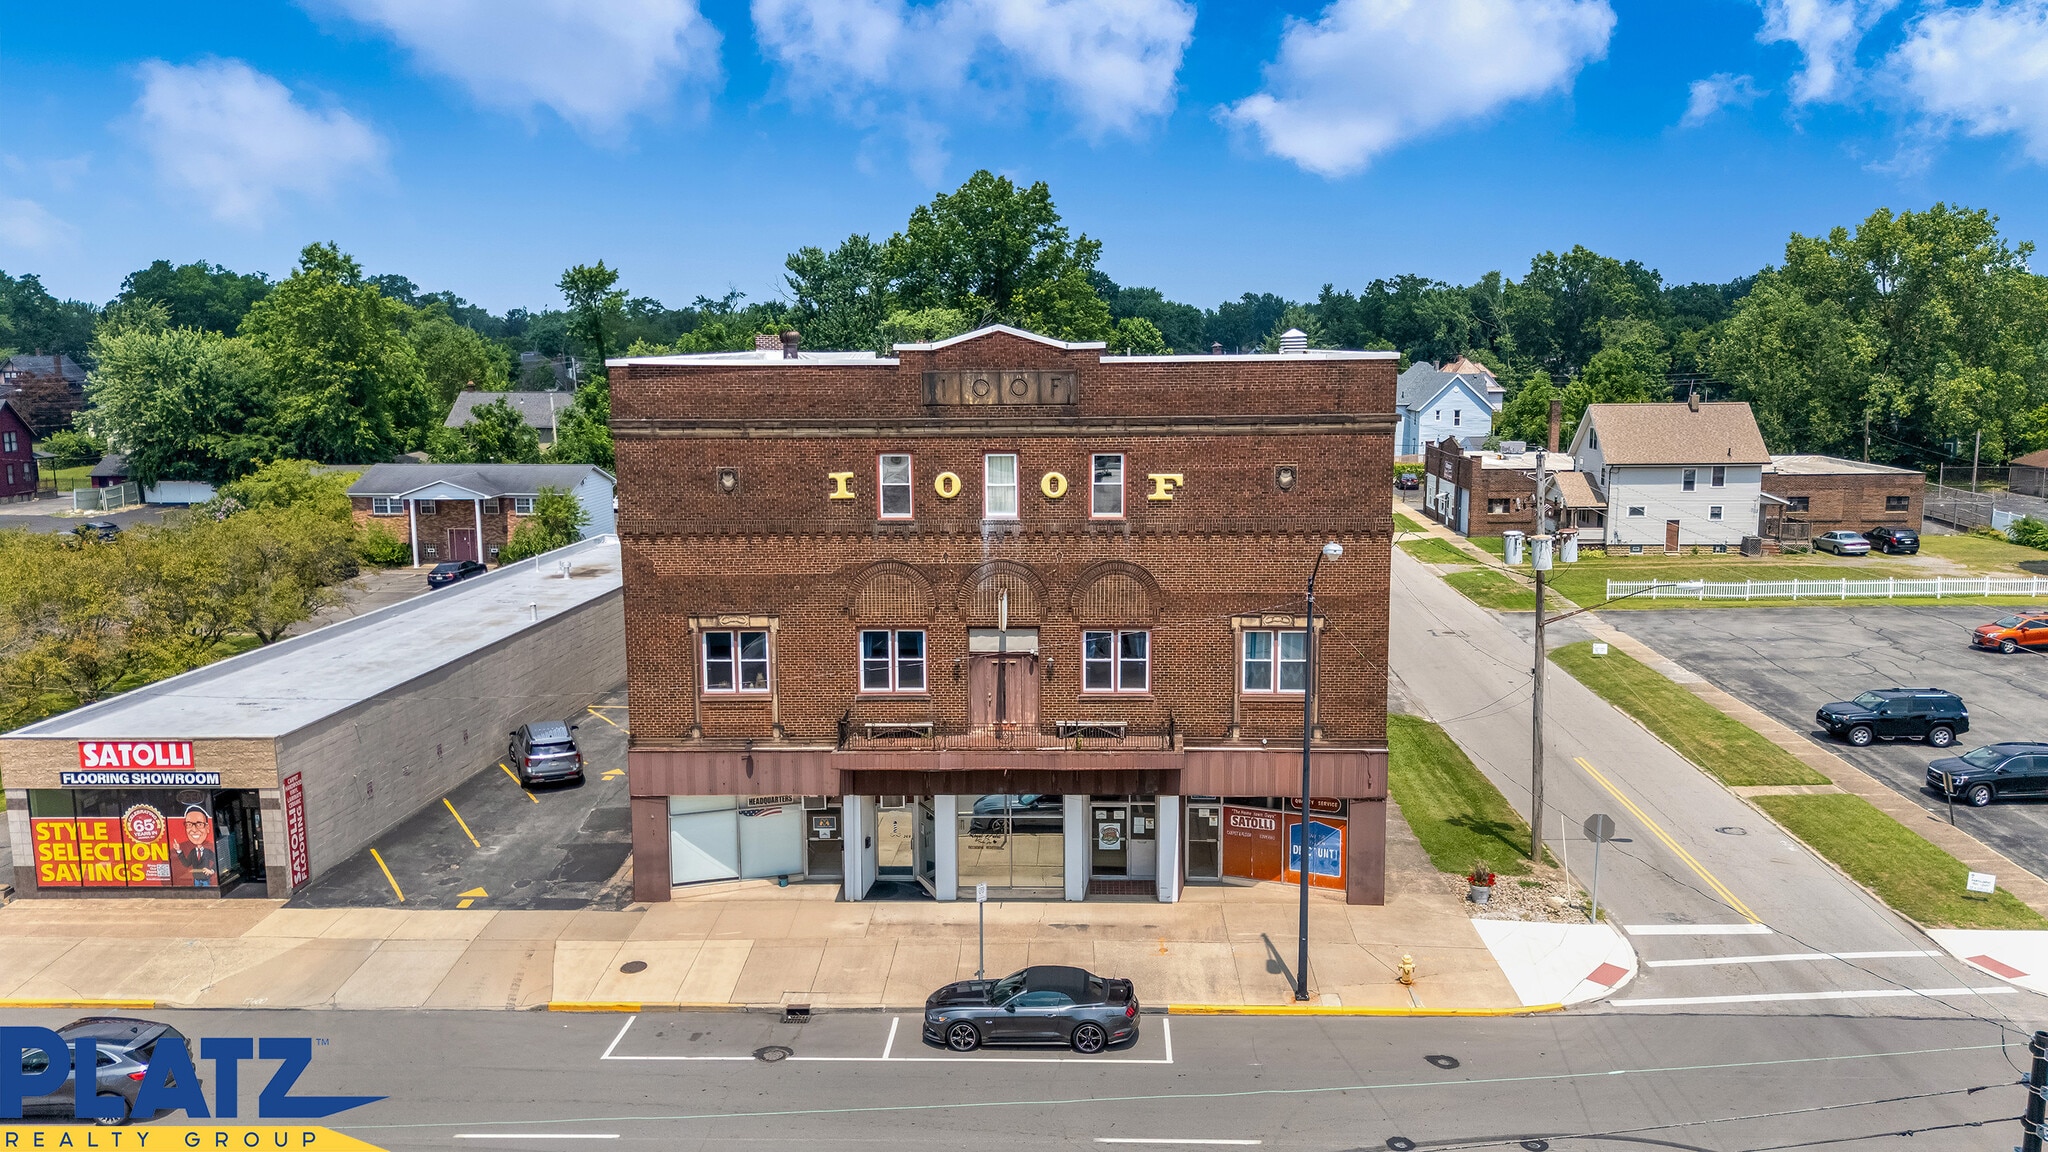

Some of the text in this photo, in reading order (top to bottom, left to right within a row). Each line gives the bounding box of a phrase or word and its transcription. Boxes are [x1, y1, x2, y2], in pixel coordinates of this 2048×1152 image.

[83, 743, 191, 767] SATOLLI
[62, 773, 219, 784] FLOORING SHOWROOM
[748, 795, 792, 805] HEADQUARTERS
[36, 822, 108, 841] STYLE
[1232, 816, 1273, 829] SATOLLI
[38, 842, 169, 862] SELECTION
[289, 807, 302, 885] SATOLLI
[296, 806, 308, 881] FLOORING
[40, 863, 145, 882] SAVINGS
